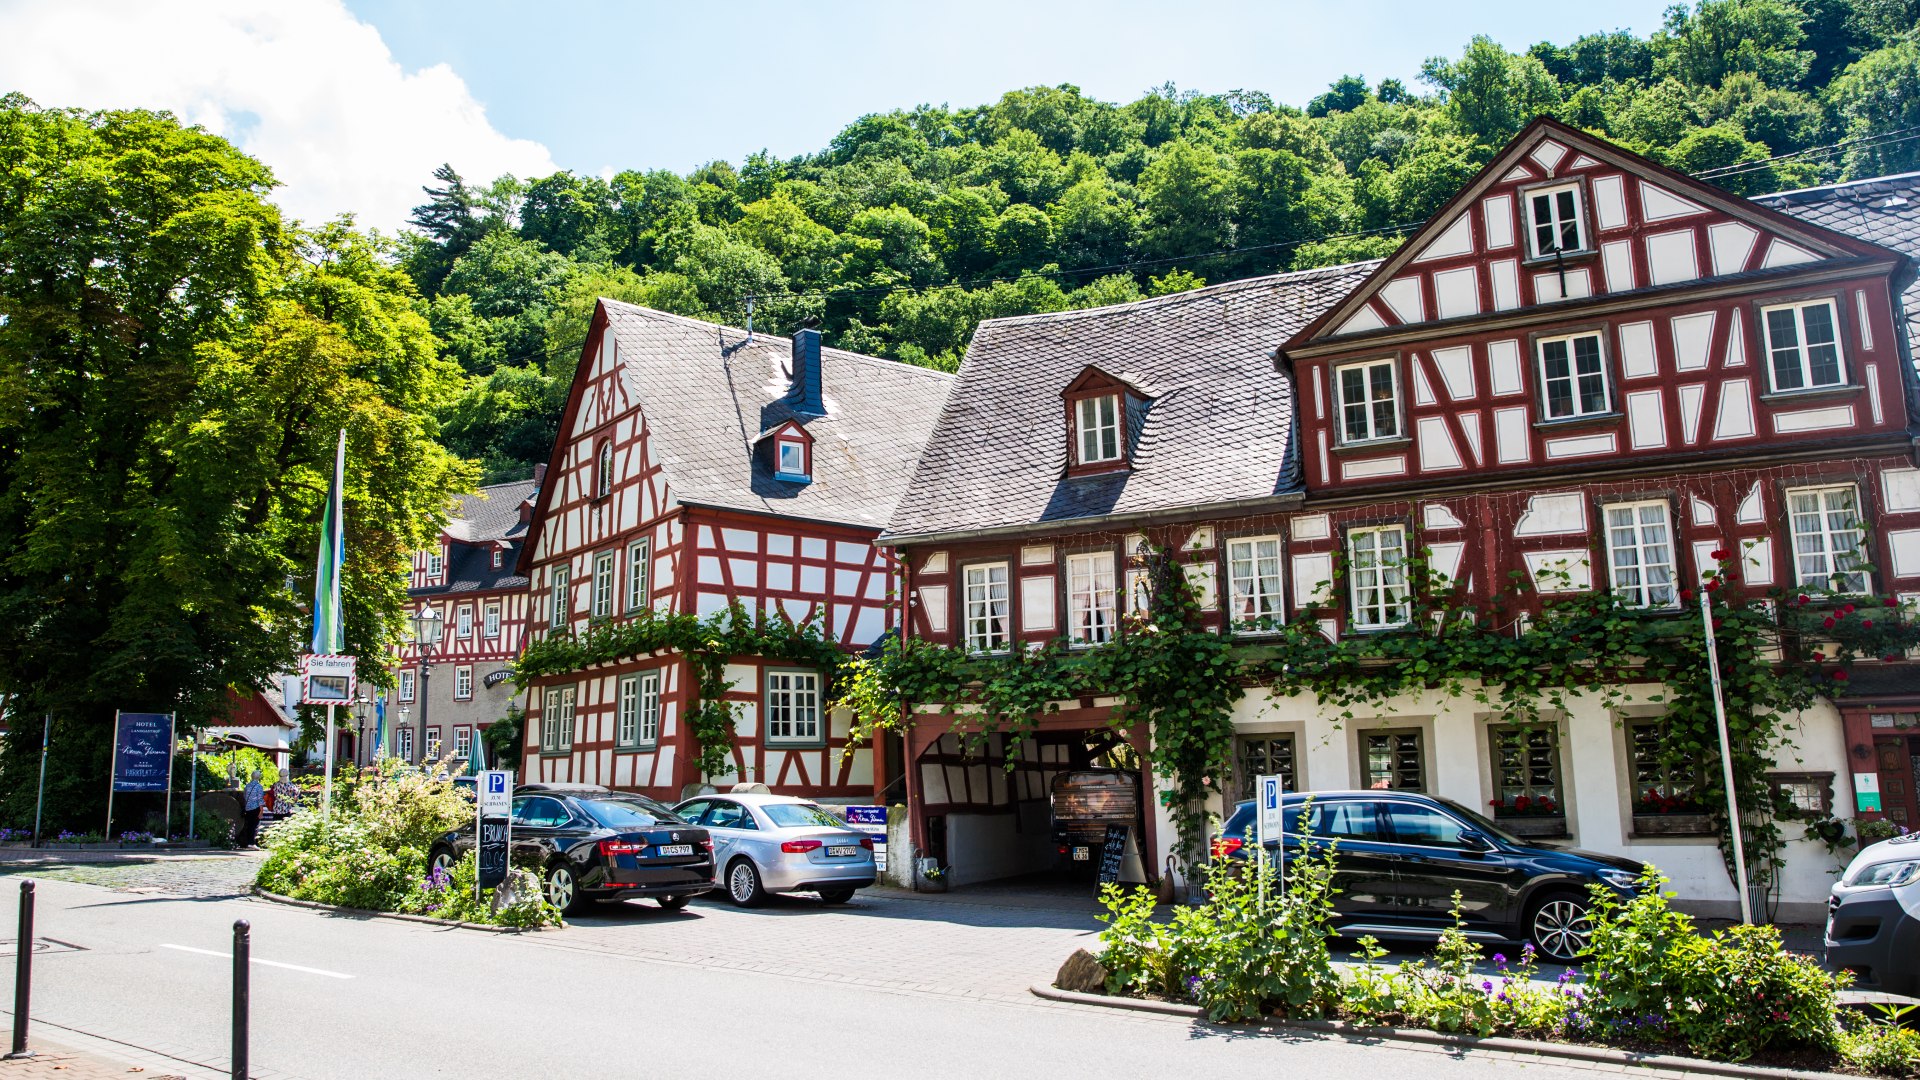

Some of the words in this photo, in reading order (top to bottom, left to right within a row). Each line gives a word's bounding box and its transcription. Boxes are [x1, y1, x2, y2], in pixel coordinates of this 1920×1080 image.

[310, 658, 323, 667] Sie
[325, 659, 351, 668] fahren
[491, 774, 503, 792] P
[1267, 783, 1275, 807] P
[483, 824, 508, 843] BRUNCH
